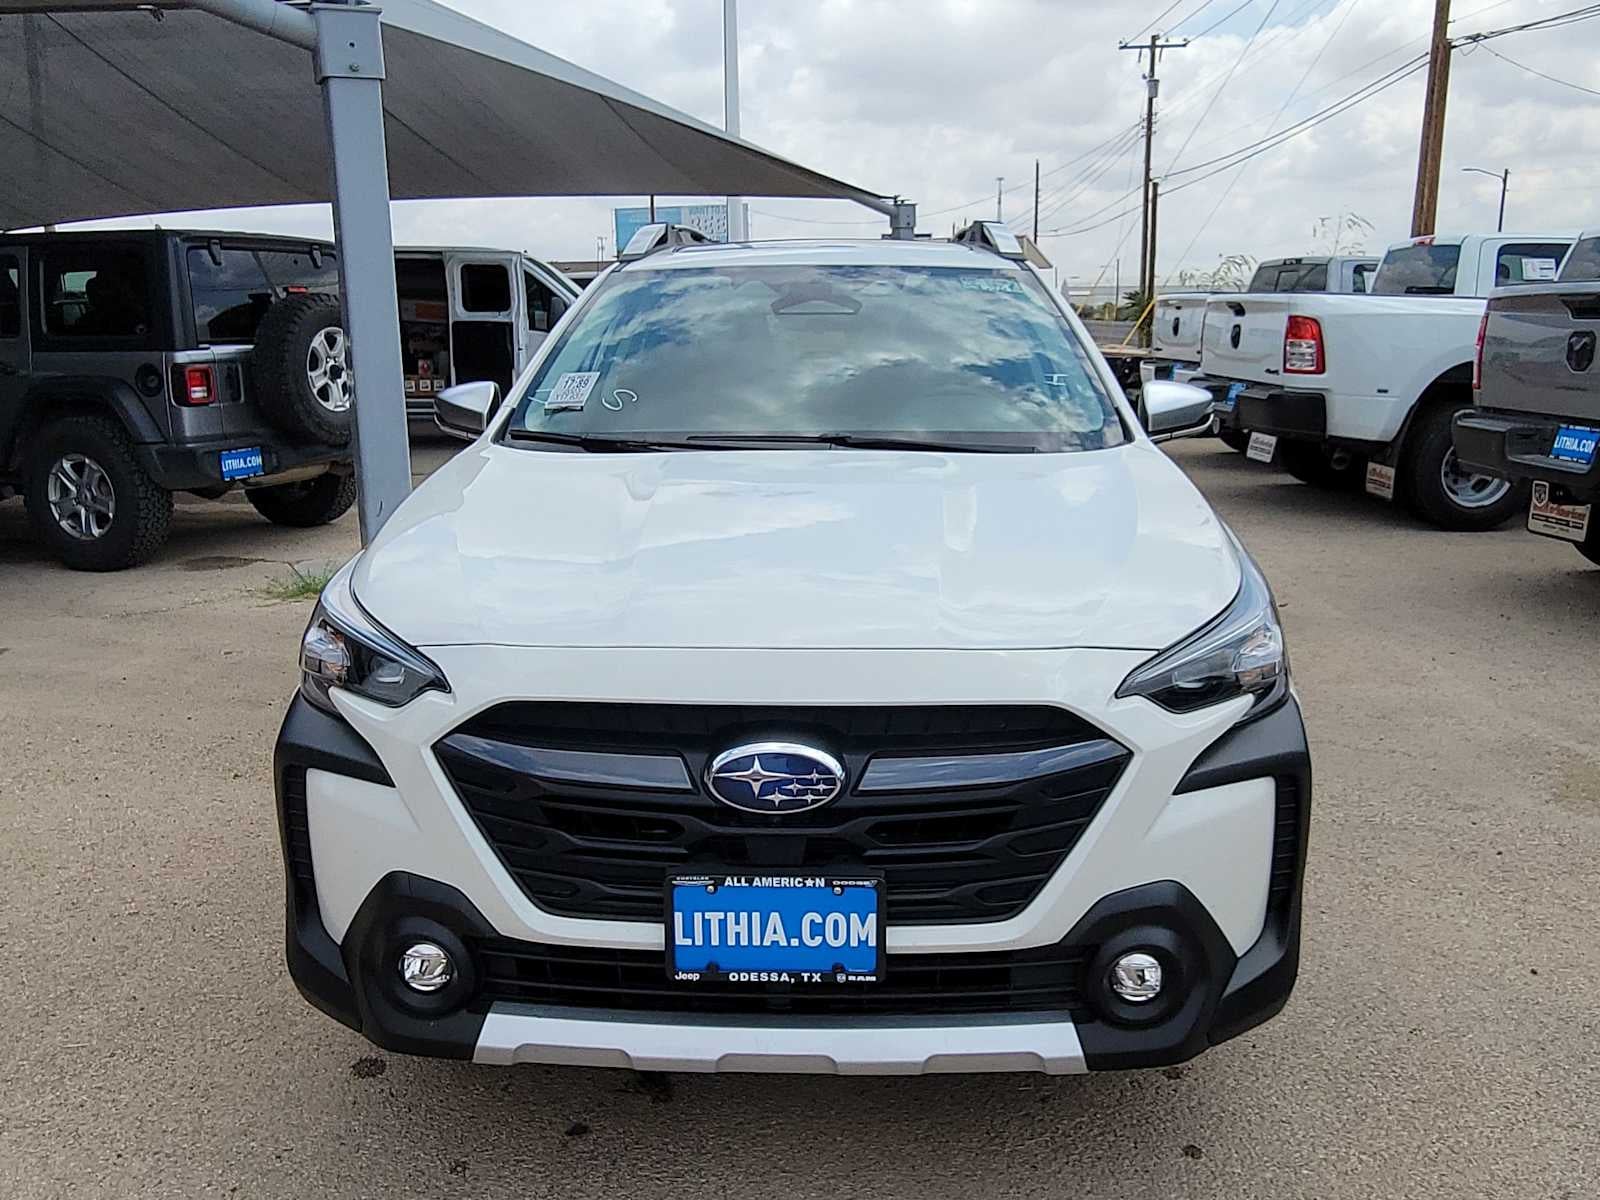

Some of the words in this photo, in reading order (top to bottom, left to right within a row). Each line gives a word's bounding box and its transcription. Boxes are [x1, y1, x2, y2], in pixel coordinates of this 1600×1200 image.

[222, 456, 262, 472] LITHIA.COM
[724, 876, 749, 887] ALL
[673, 911, 877, 947] LITHIA.COM
[674, 971, 700, 982] Jeep
[728, 972, 796, 984] ODESSA,
[801, 972, 822, 983] TX
